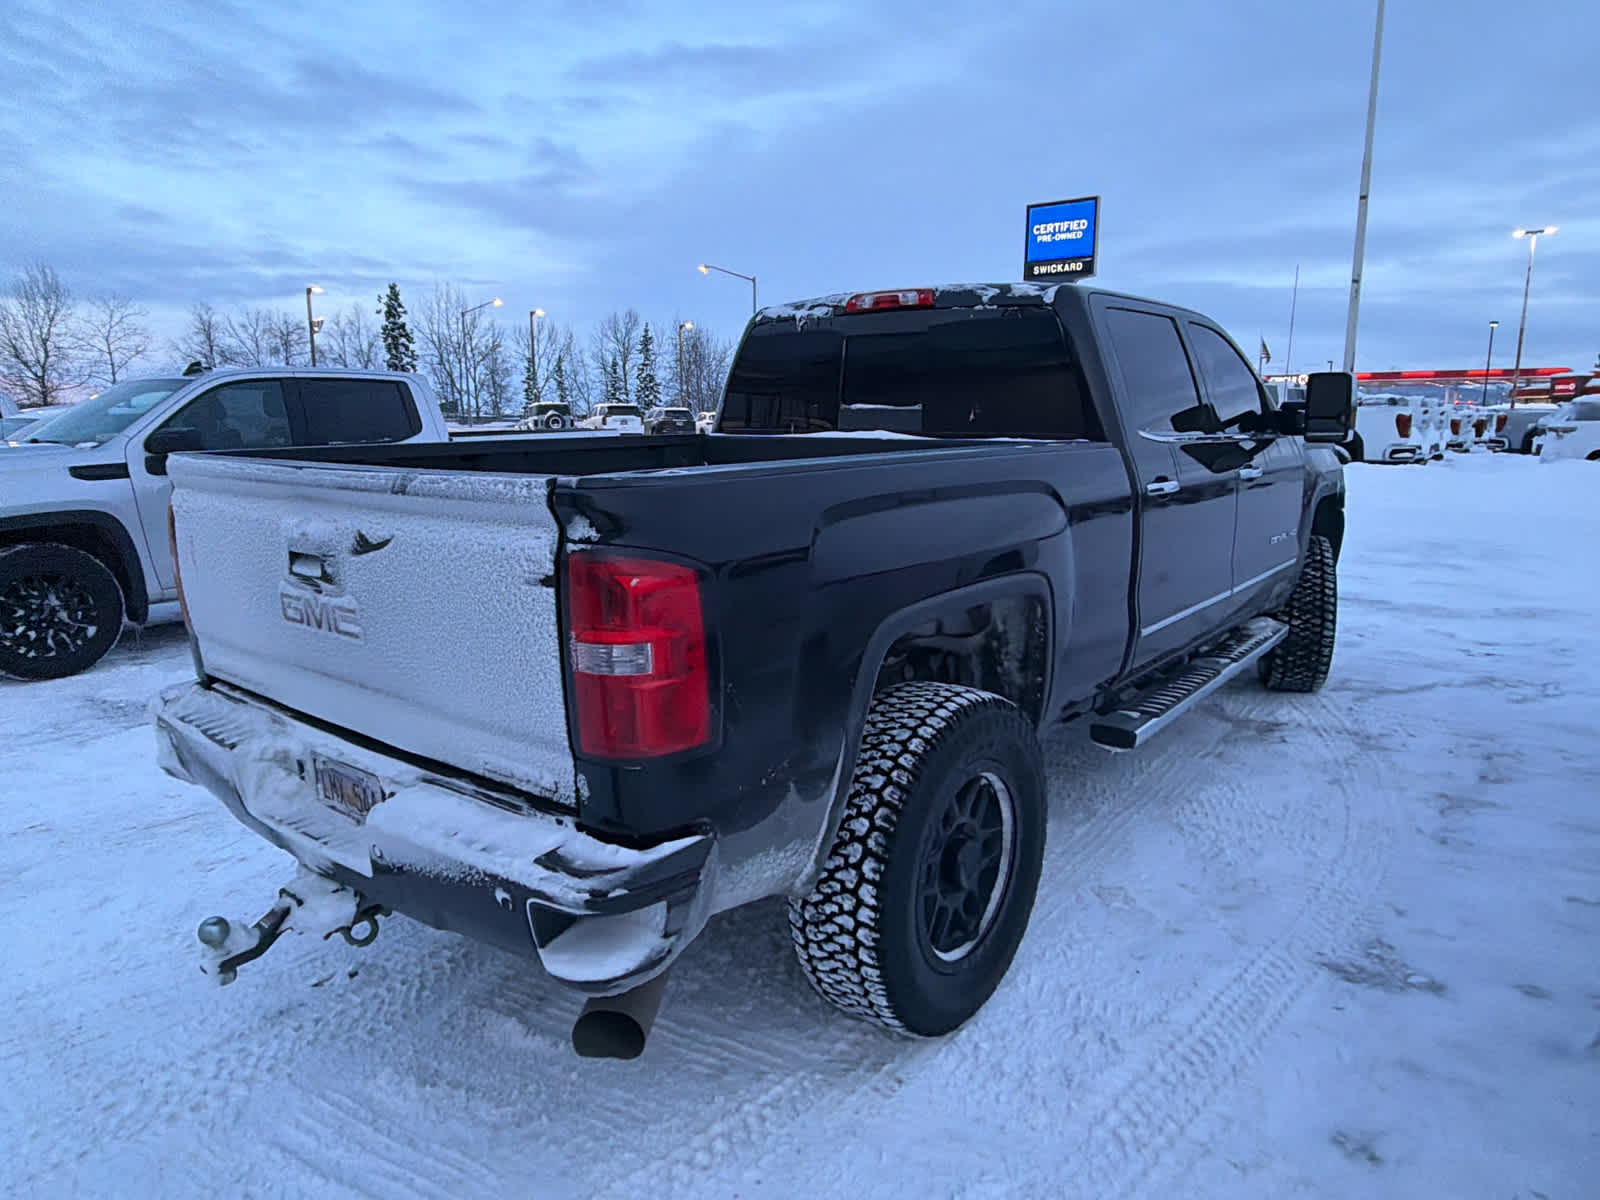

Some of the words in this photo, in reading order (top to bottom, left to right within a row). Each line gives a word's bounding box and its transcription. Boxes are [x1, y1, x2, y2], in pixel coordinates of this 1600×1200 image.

[1033, 219, 1088, 235] CERTIFIED
[1036, 231, 1083, 243] PRE-OWNED
[1033, 262, 1083, 275] SWICKARD
[280, 592, 361, 639] GMC
